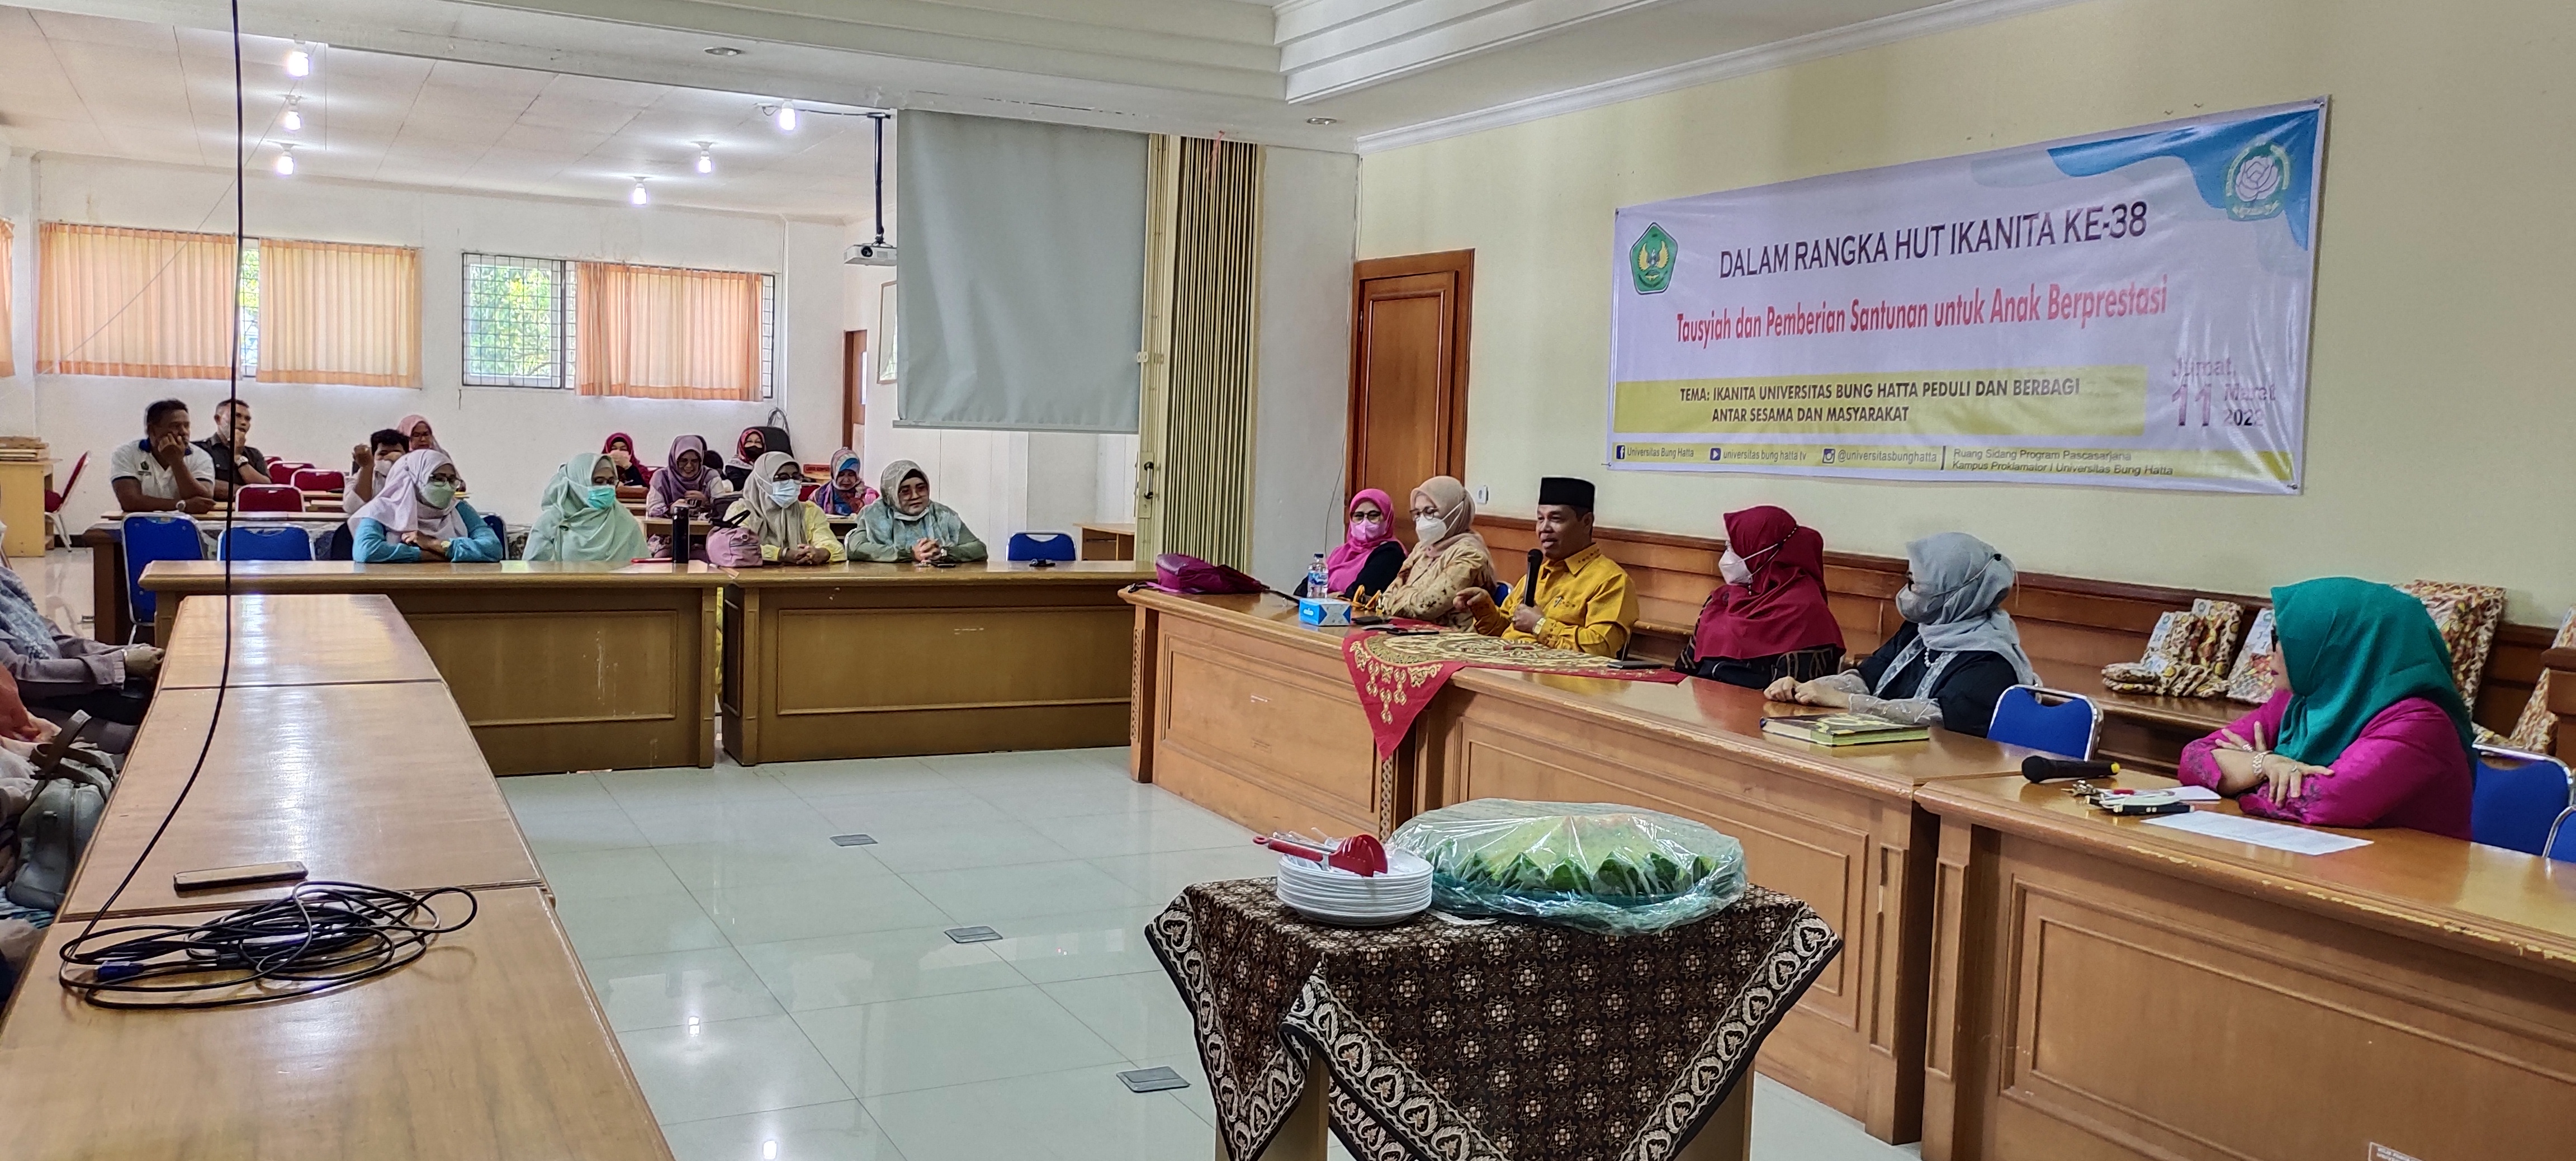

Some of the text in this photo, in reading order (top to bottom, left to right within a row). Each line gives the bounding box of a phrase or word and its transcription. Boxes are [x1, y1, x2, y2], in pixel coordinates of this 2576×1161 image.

[1720, 201, 2147, 279] DALAM RANGKA HUT IKANITA KE-38
[1677, 273, 2168, 349] Tausyiah dan Pemberian Santunan untuk Anak Berprestasi
[1680, 378, 2080, 402] TEMA: IKANITA UNIVERSITAS BUNG HATTA PEDULI DAN BERBAGI
[2171, 383, 2212, 426] 11
[1712, 406, 1909, 422] ANTAR SESAMA DAN MASYARAKAT
[1627, 447, 1694, 459] Universitas Bung Hatta
[1723, 450, 1760, 459] universitas
[1761, 450, 1778, 462] bung
[1780, 450, 1798, 460] hatta
[1838, 449, 1936, 464] @universitasbunghatta
[1953, 449, 2132, 462] Ruang Sidang Program Pascasarjana
[1952, 460, 1988, 471] Kampus
[1990, 461, 2047, 472] Proklamator
[2056, 463, 2110, 474] Universitas
[2114, 465, 2141, 476] Bung
[2144, 465, 2173, 475] Hatta
